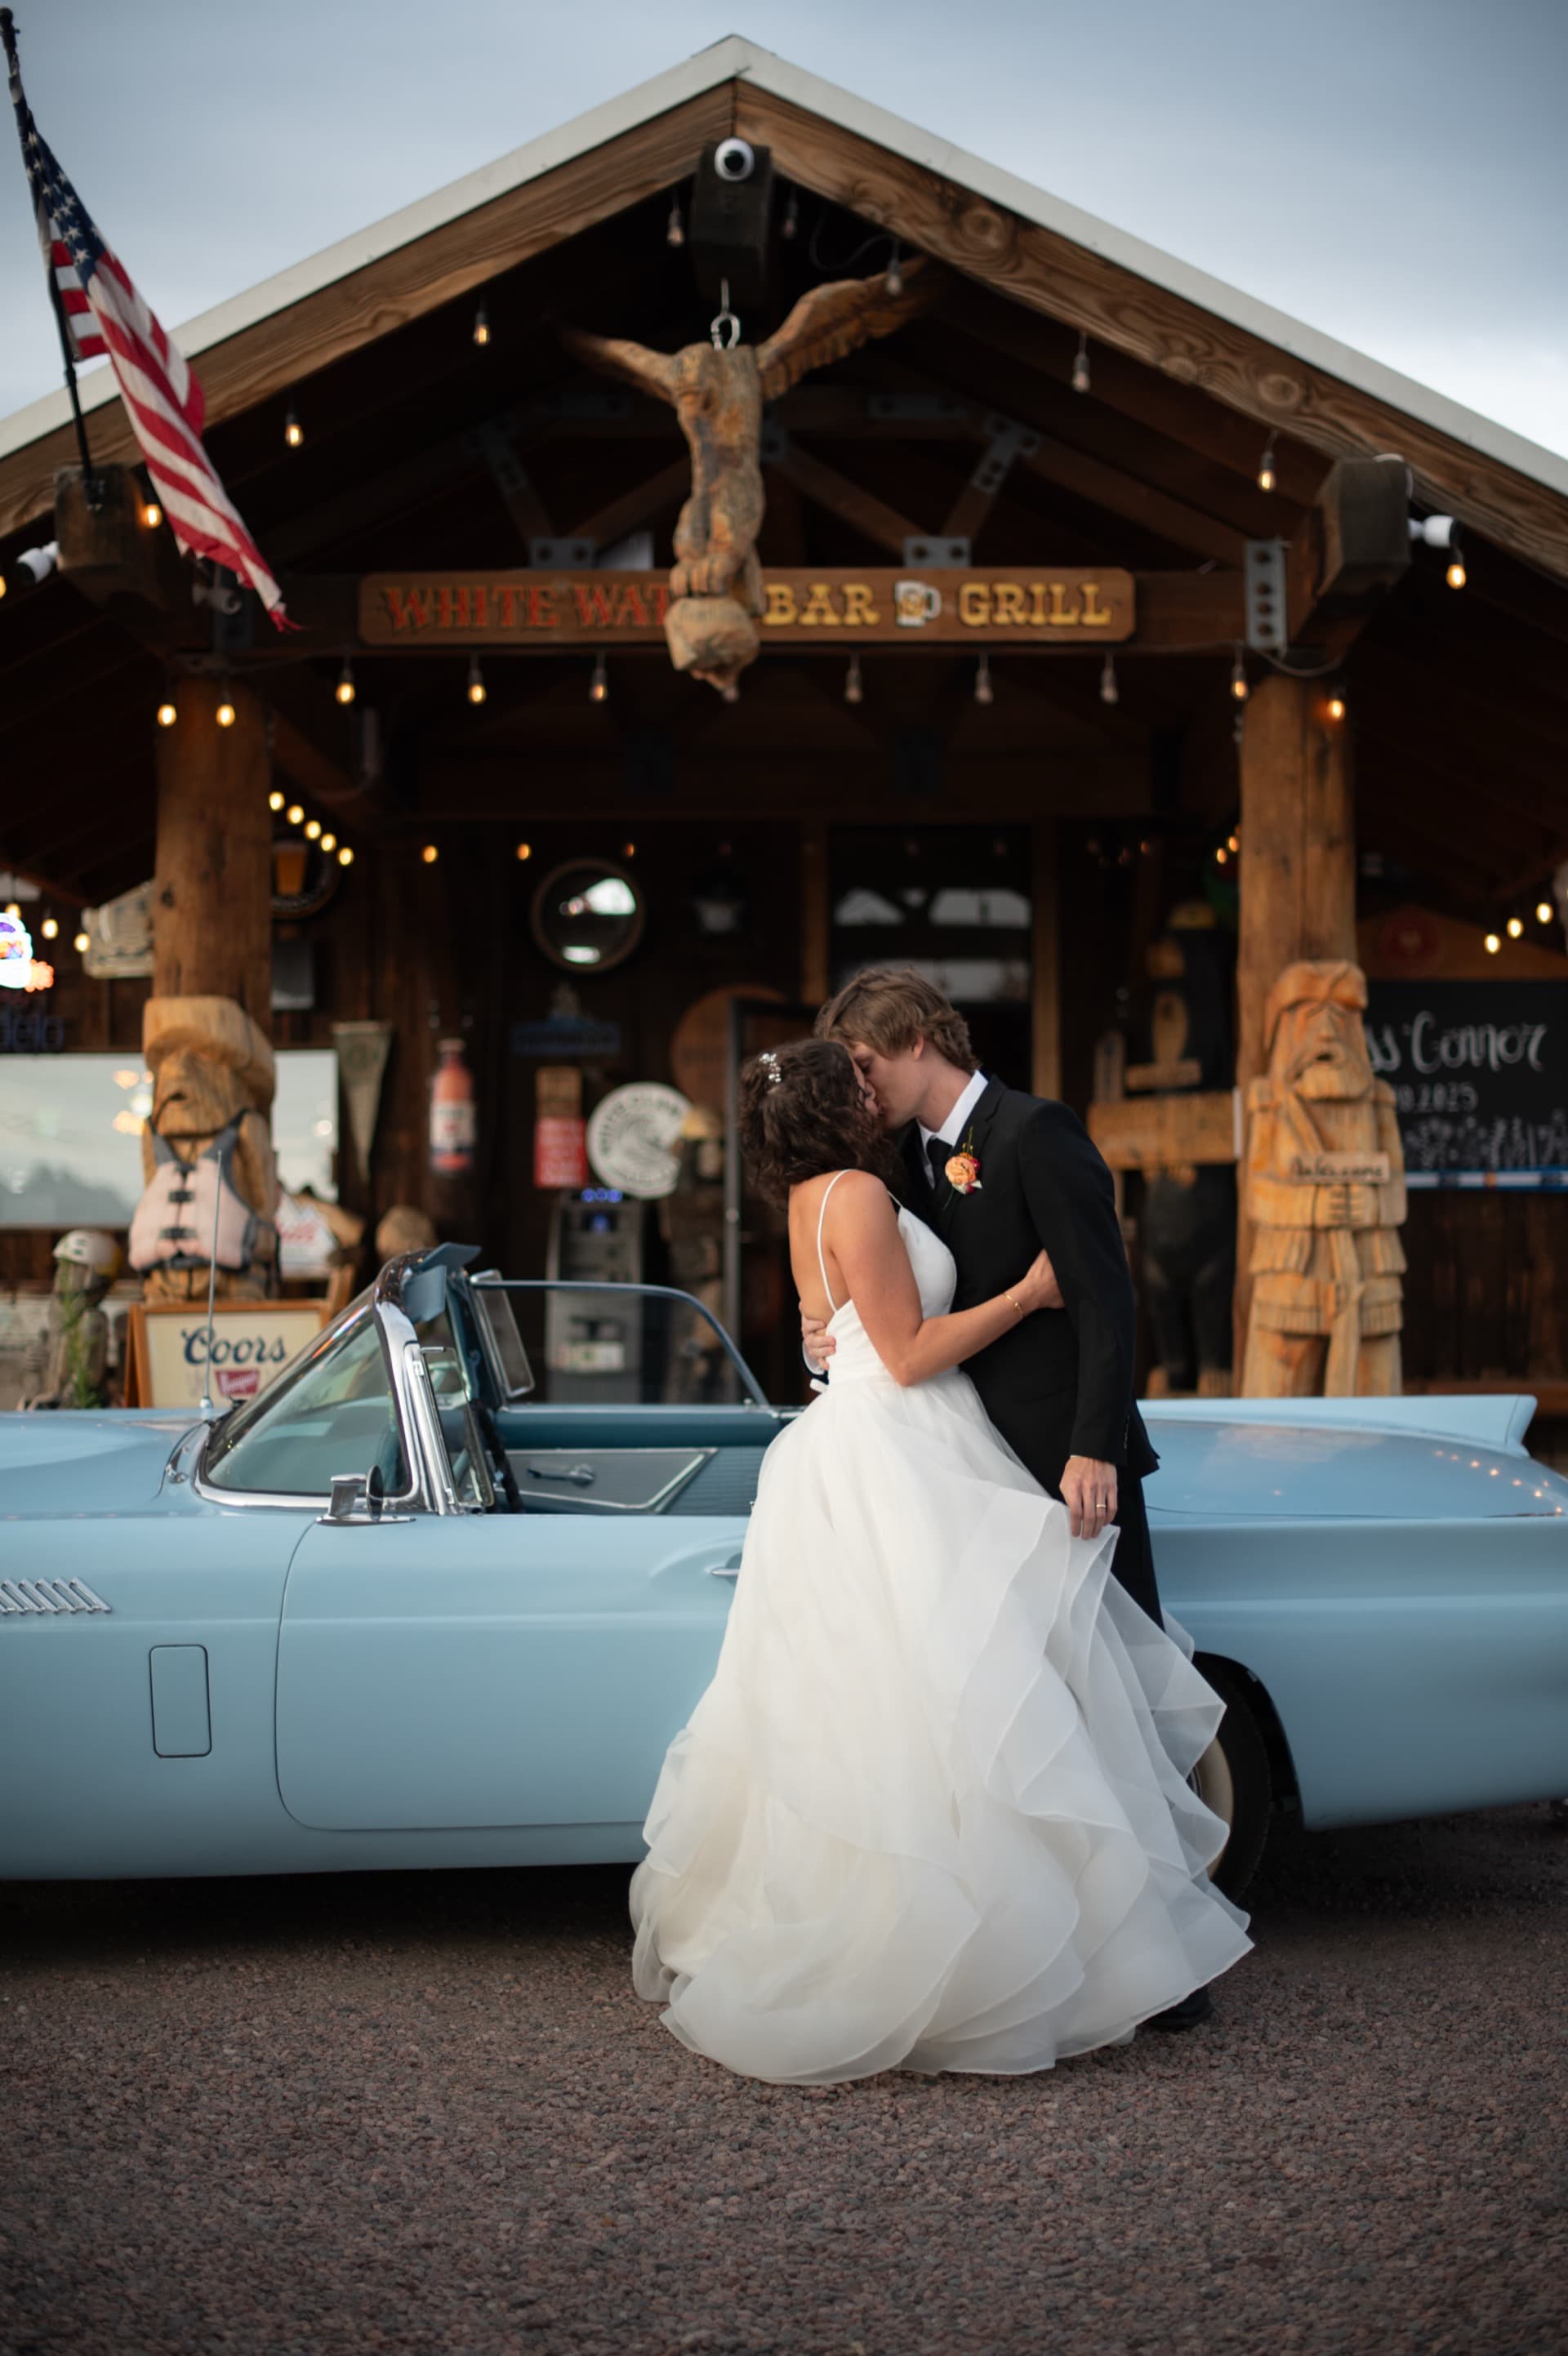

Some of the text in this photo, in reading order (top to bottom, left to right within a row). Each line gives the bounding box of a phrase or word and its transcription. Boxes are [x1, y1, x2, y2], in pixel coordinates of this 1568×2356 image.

[382, 582, 1111, 629] WHITE WAT BAR GRILL
[180, 1325, 287, 1365] Coors
